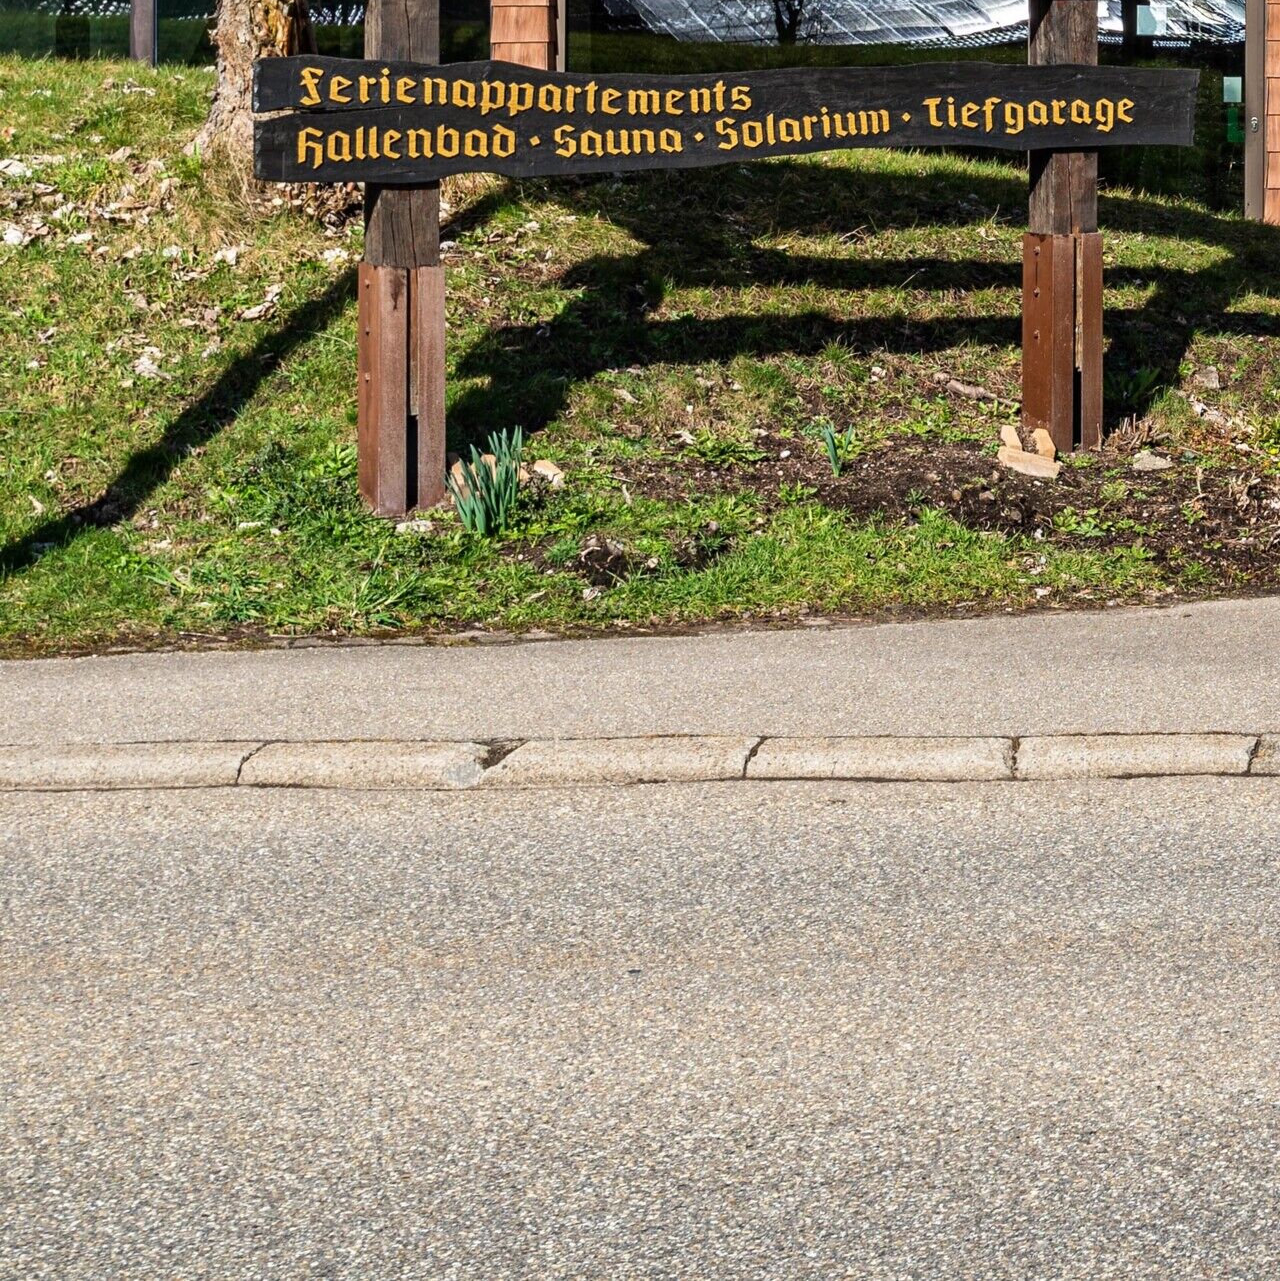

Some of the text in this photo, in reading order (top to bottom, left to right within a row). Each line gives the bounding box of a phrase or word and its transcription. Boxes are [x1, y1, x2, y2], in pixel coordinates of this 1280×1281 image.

[299, 67, 752, 116] Ferienappartements
[297, 96, 1135, 169] Hallenbad Sauna Solarium Tiefgarage
